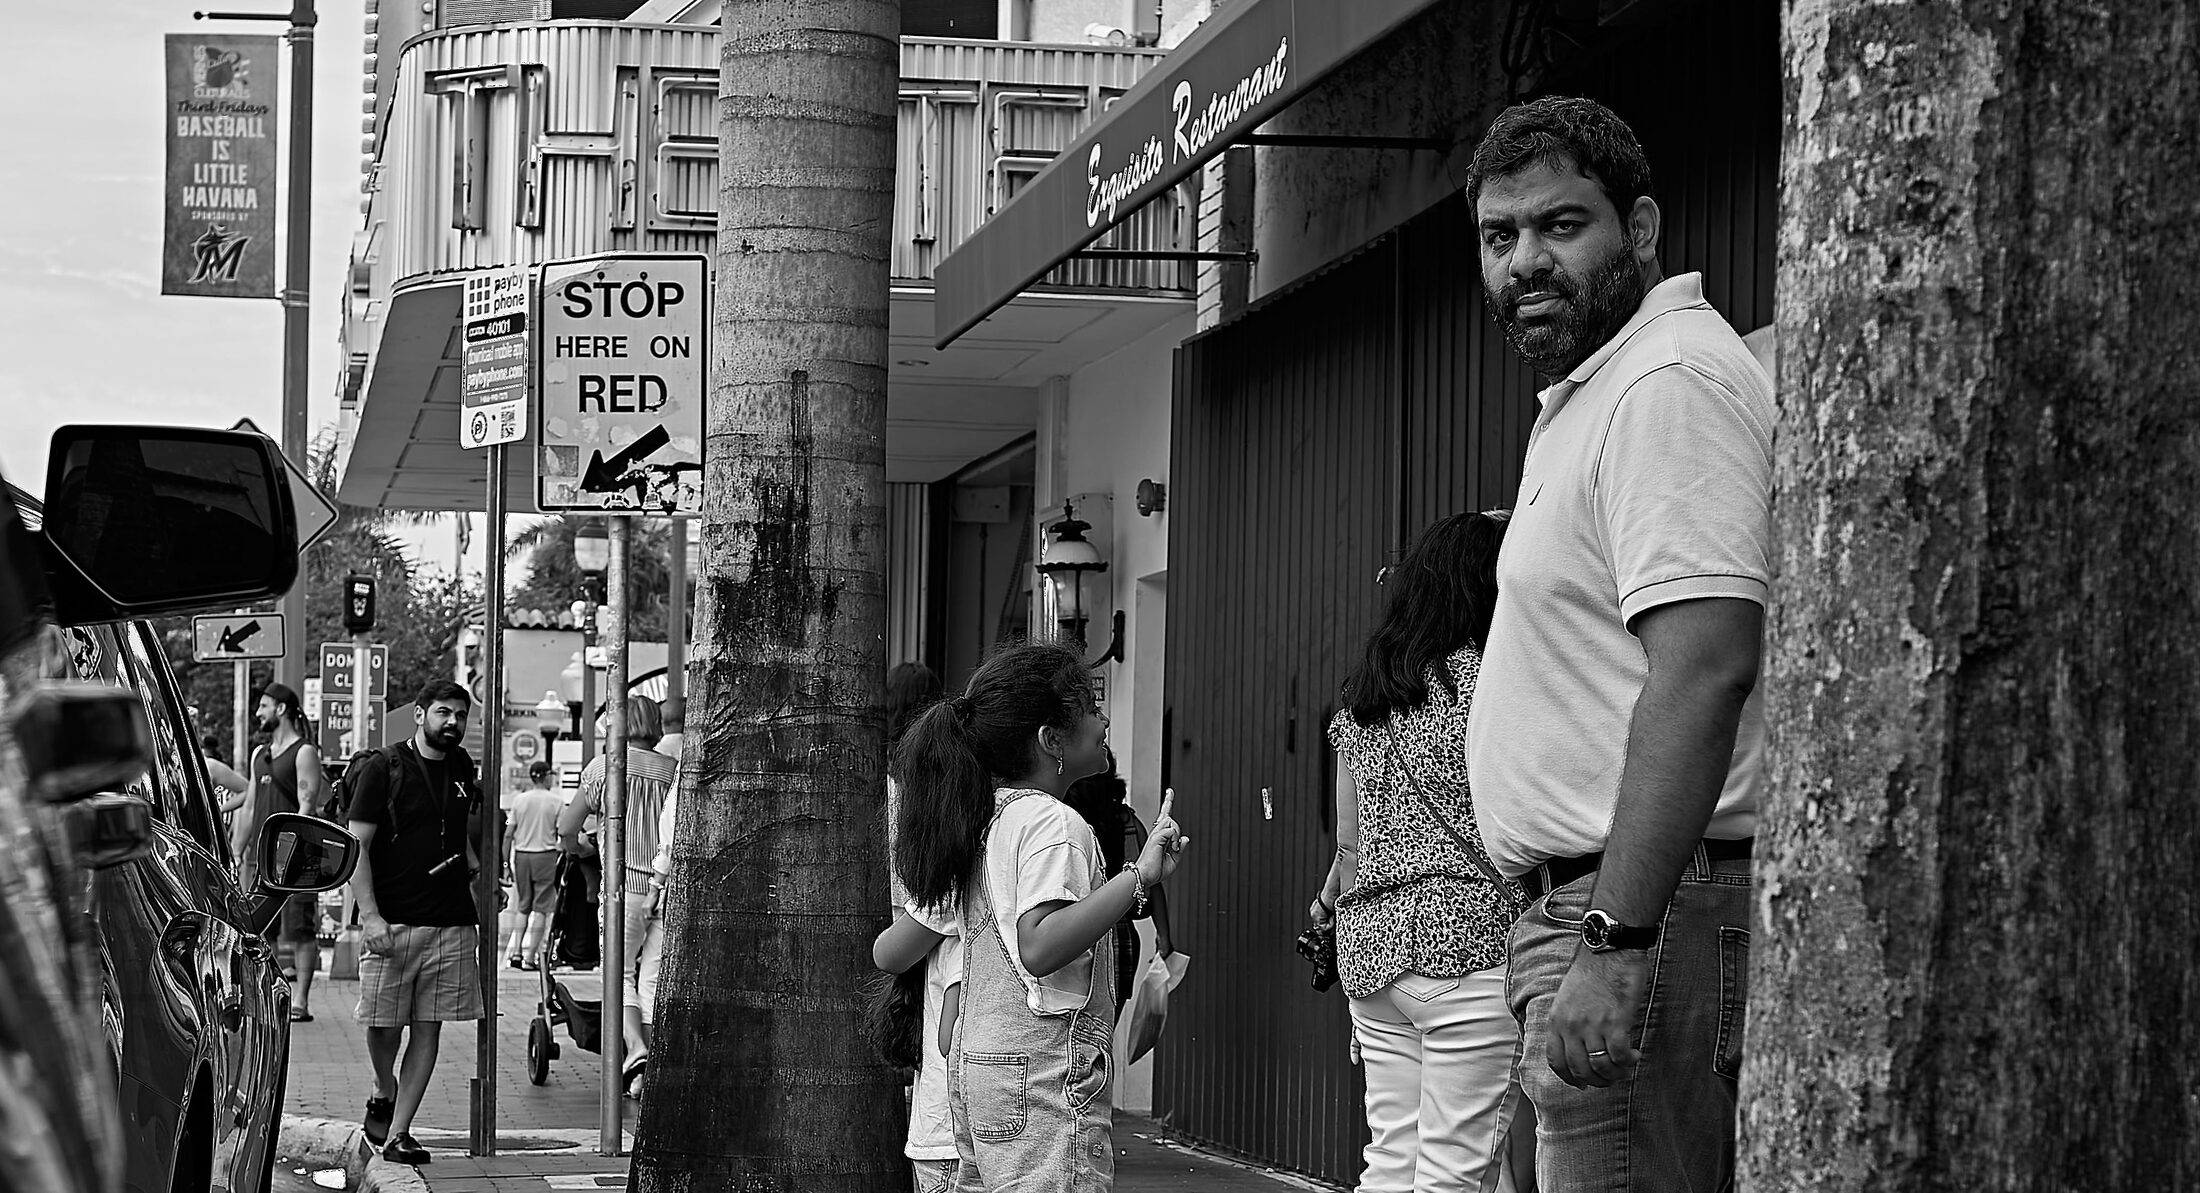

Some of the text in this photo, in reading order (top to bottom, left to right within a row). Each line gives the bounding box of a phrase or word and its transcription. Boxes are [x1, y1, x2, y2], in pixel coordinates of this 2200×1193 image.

[177, 101, 269, 116] Third Fridays
[177, 115, 265, 138] BASEBALL
[1087, 36, 1288, 229] Exquisito Restaurant
[212, 140, 230, 161] IS
[193, 163, 248, 185] LITTLE
[183, 186, 258, 209] HAVANA
[494, 293, 525, 315] phone
[562, 280, 685, 319] STOP
[487, 318, 511, 337] 40101
[555, 335, 691, 359] HERE ON
[578, 374, 668, 413] RED
